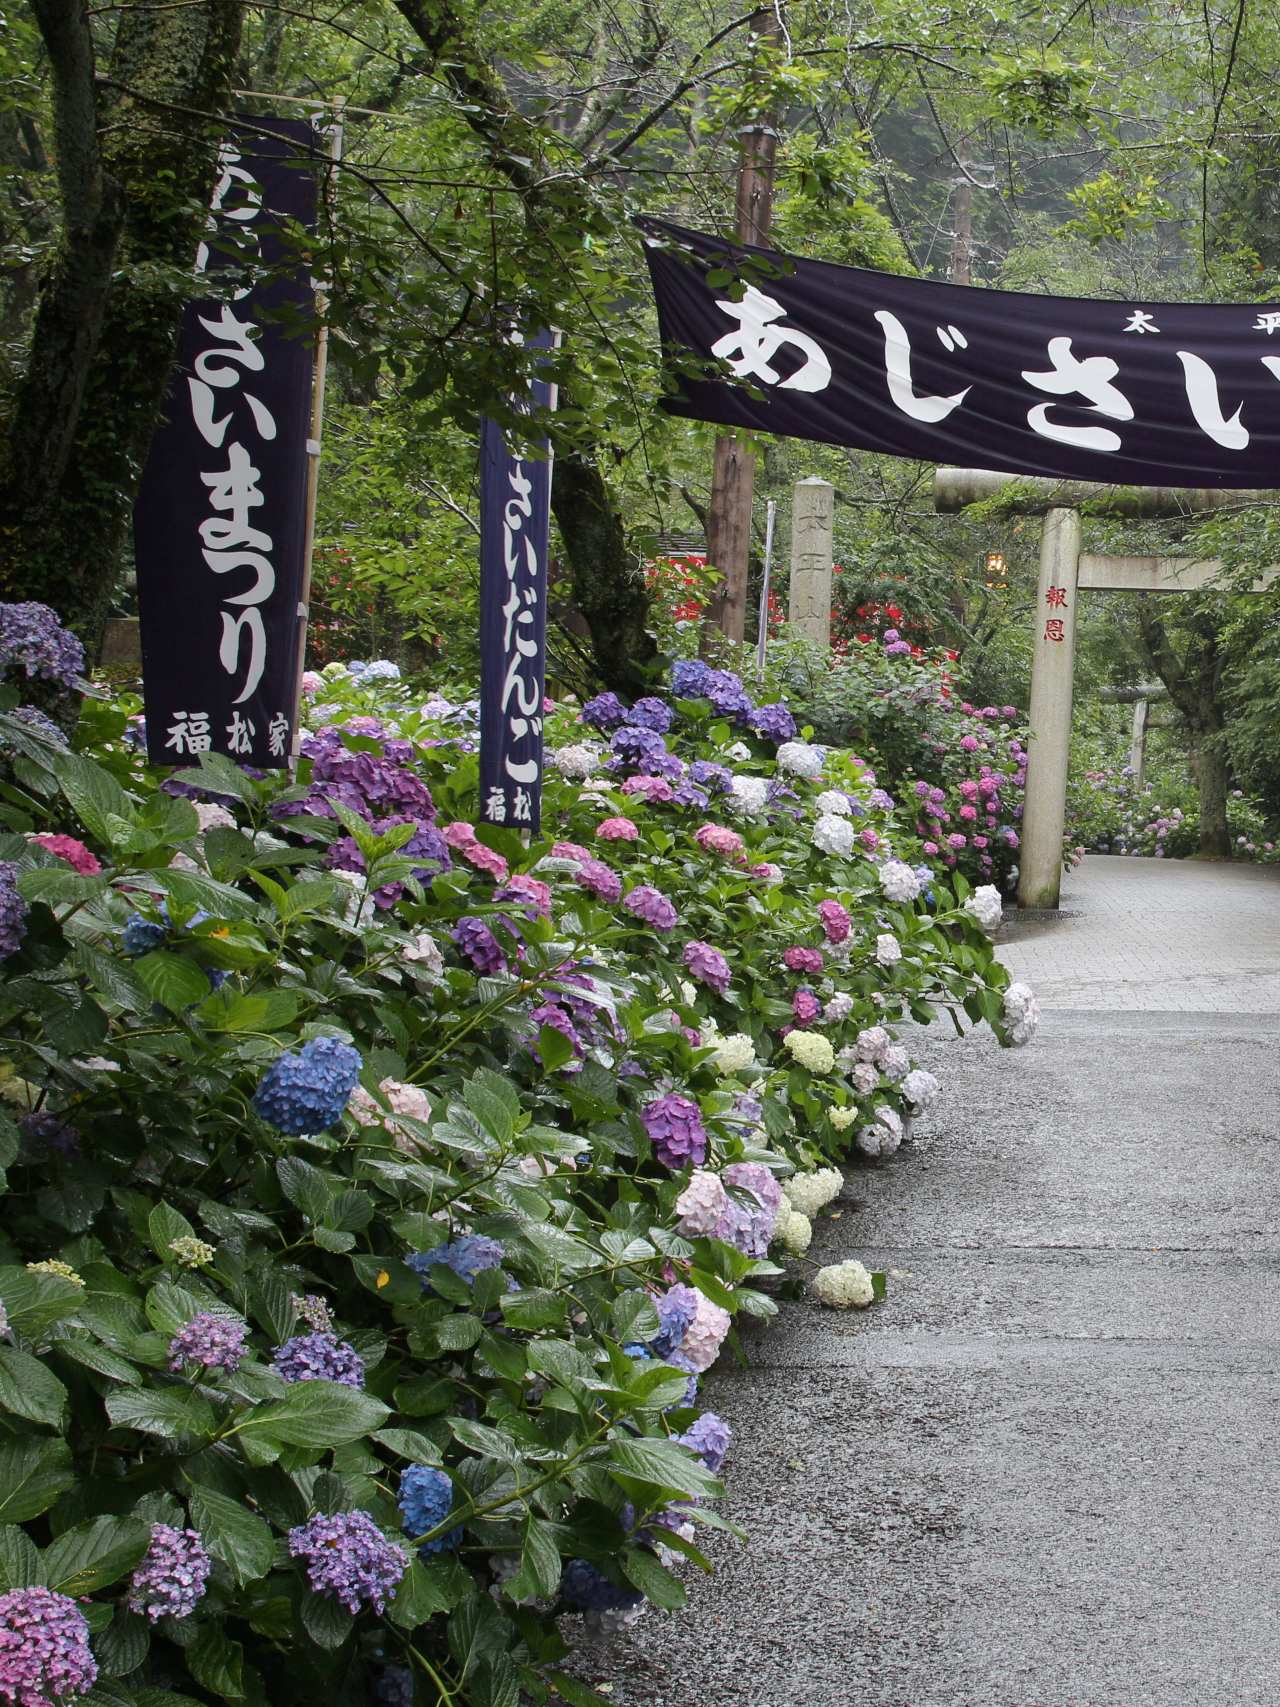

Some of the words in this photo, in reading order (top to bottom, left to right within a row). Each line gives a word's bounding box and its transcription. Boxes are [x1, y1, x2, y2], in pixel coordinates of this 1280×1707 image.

[501, 308, 540, 783] さいだんご
[1043, 586, 1068, 642] 報恩
[164, 711, 290, 757] 福松家
